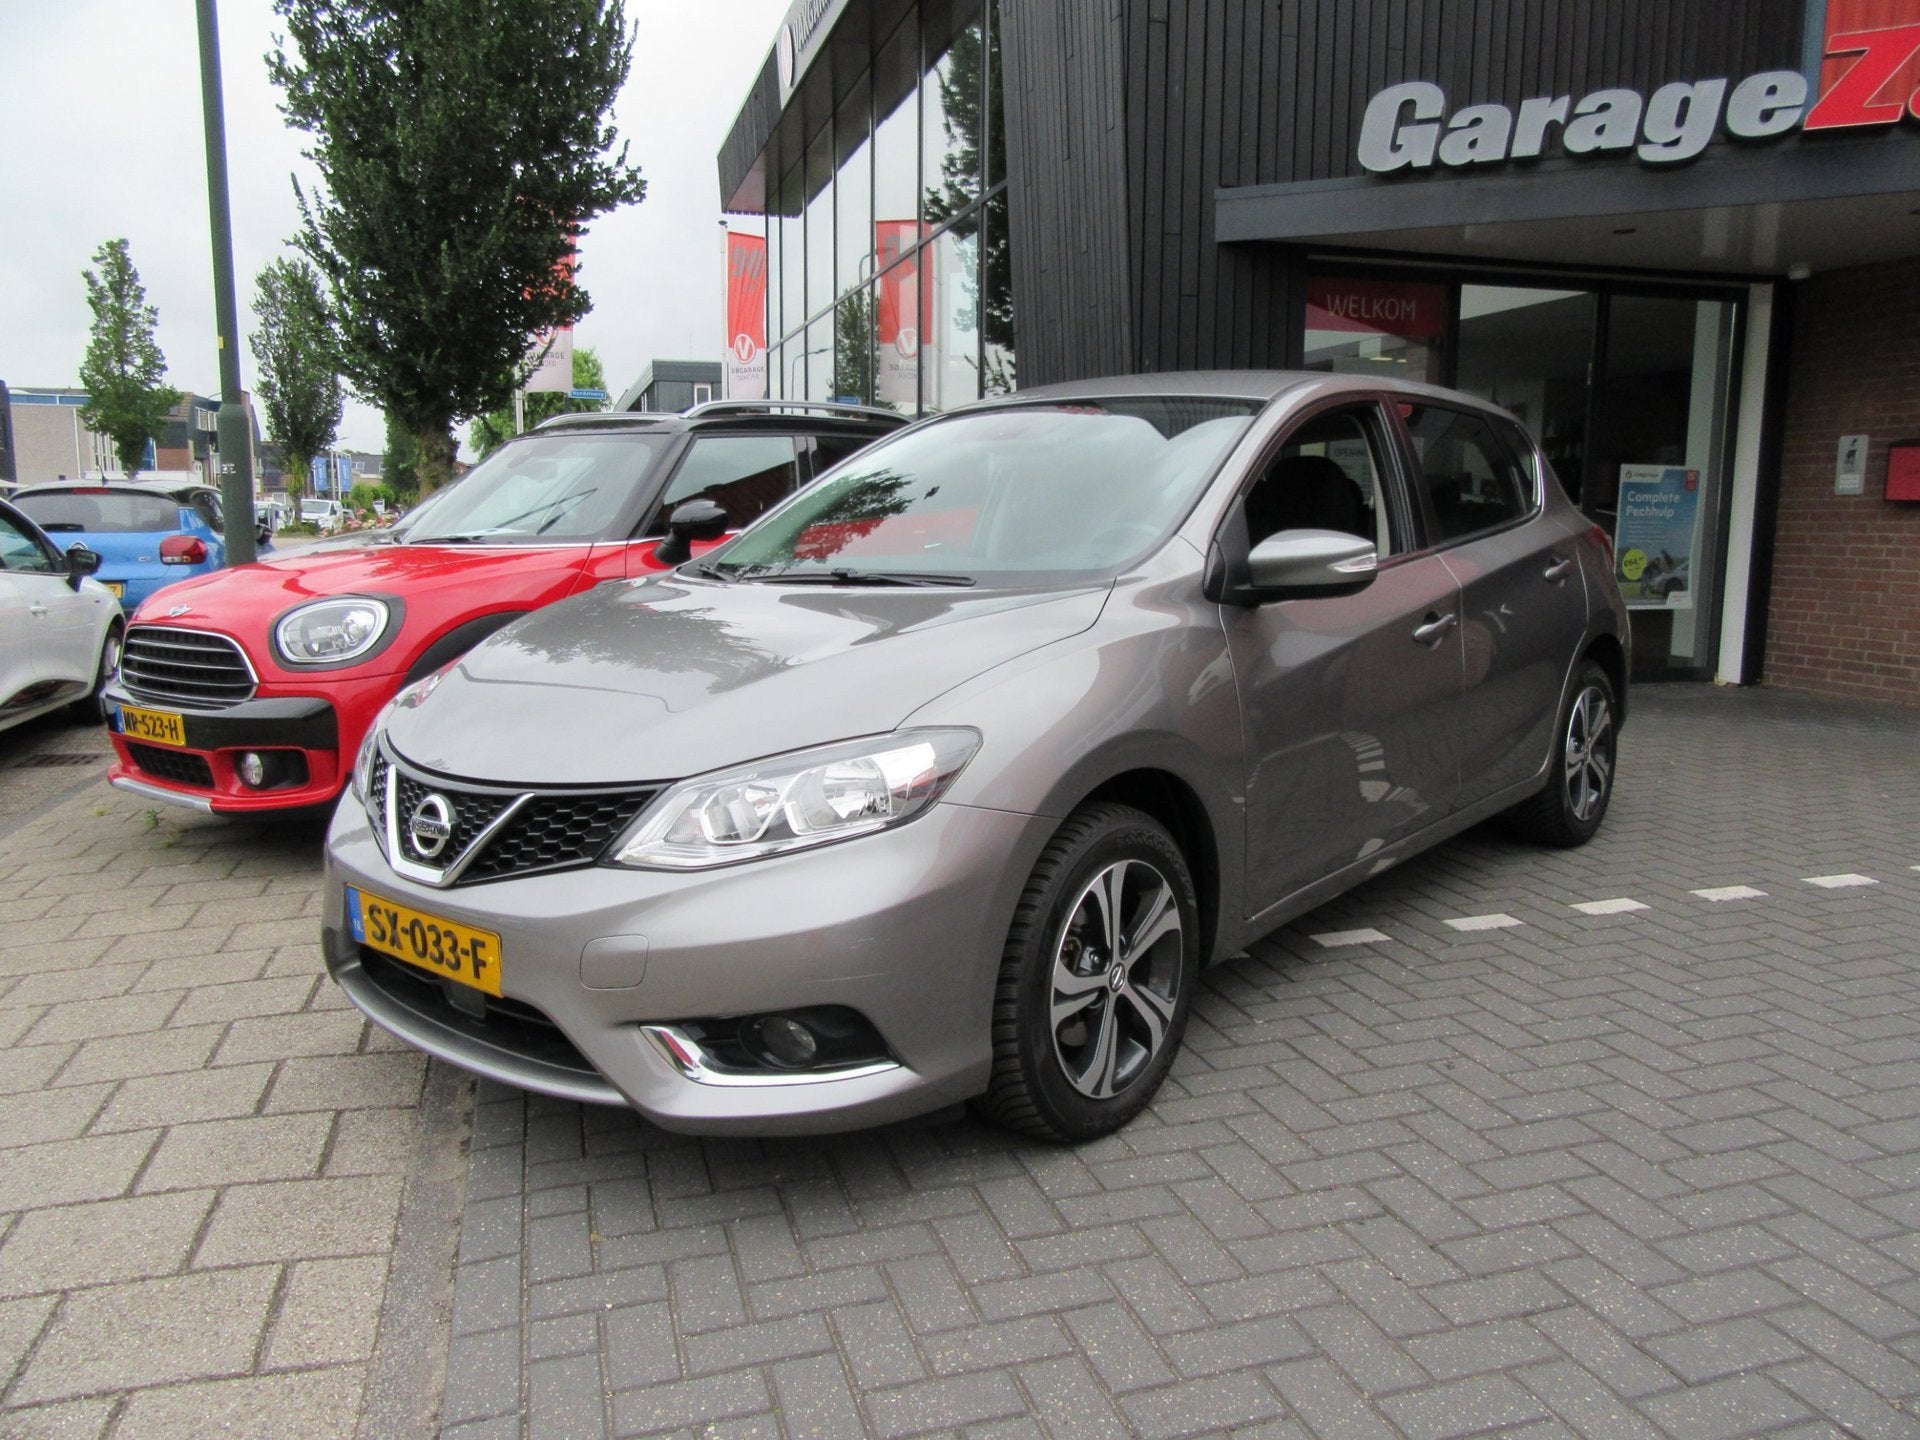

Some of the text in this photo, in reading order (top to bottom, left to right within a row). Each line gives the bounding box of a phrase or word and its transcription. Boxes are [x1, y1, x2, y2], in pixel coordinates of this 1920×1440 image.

[1803, 22, 1920, 130] Z
[1326, 294, 1417, 321] WELKOM
[1627, 490, 1680, 505] Complete
[1626, 505, 1675, 519] Pechhulp
[368, 903, 488, 979] SX-033-F
